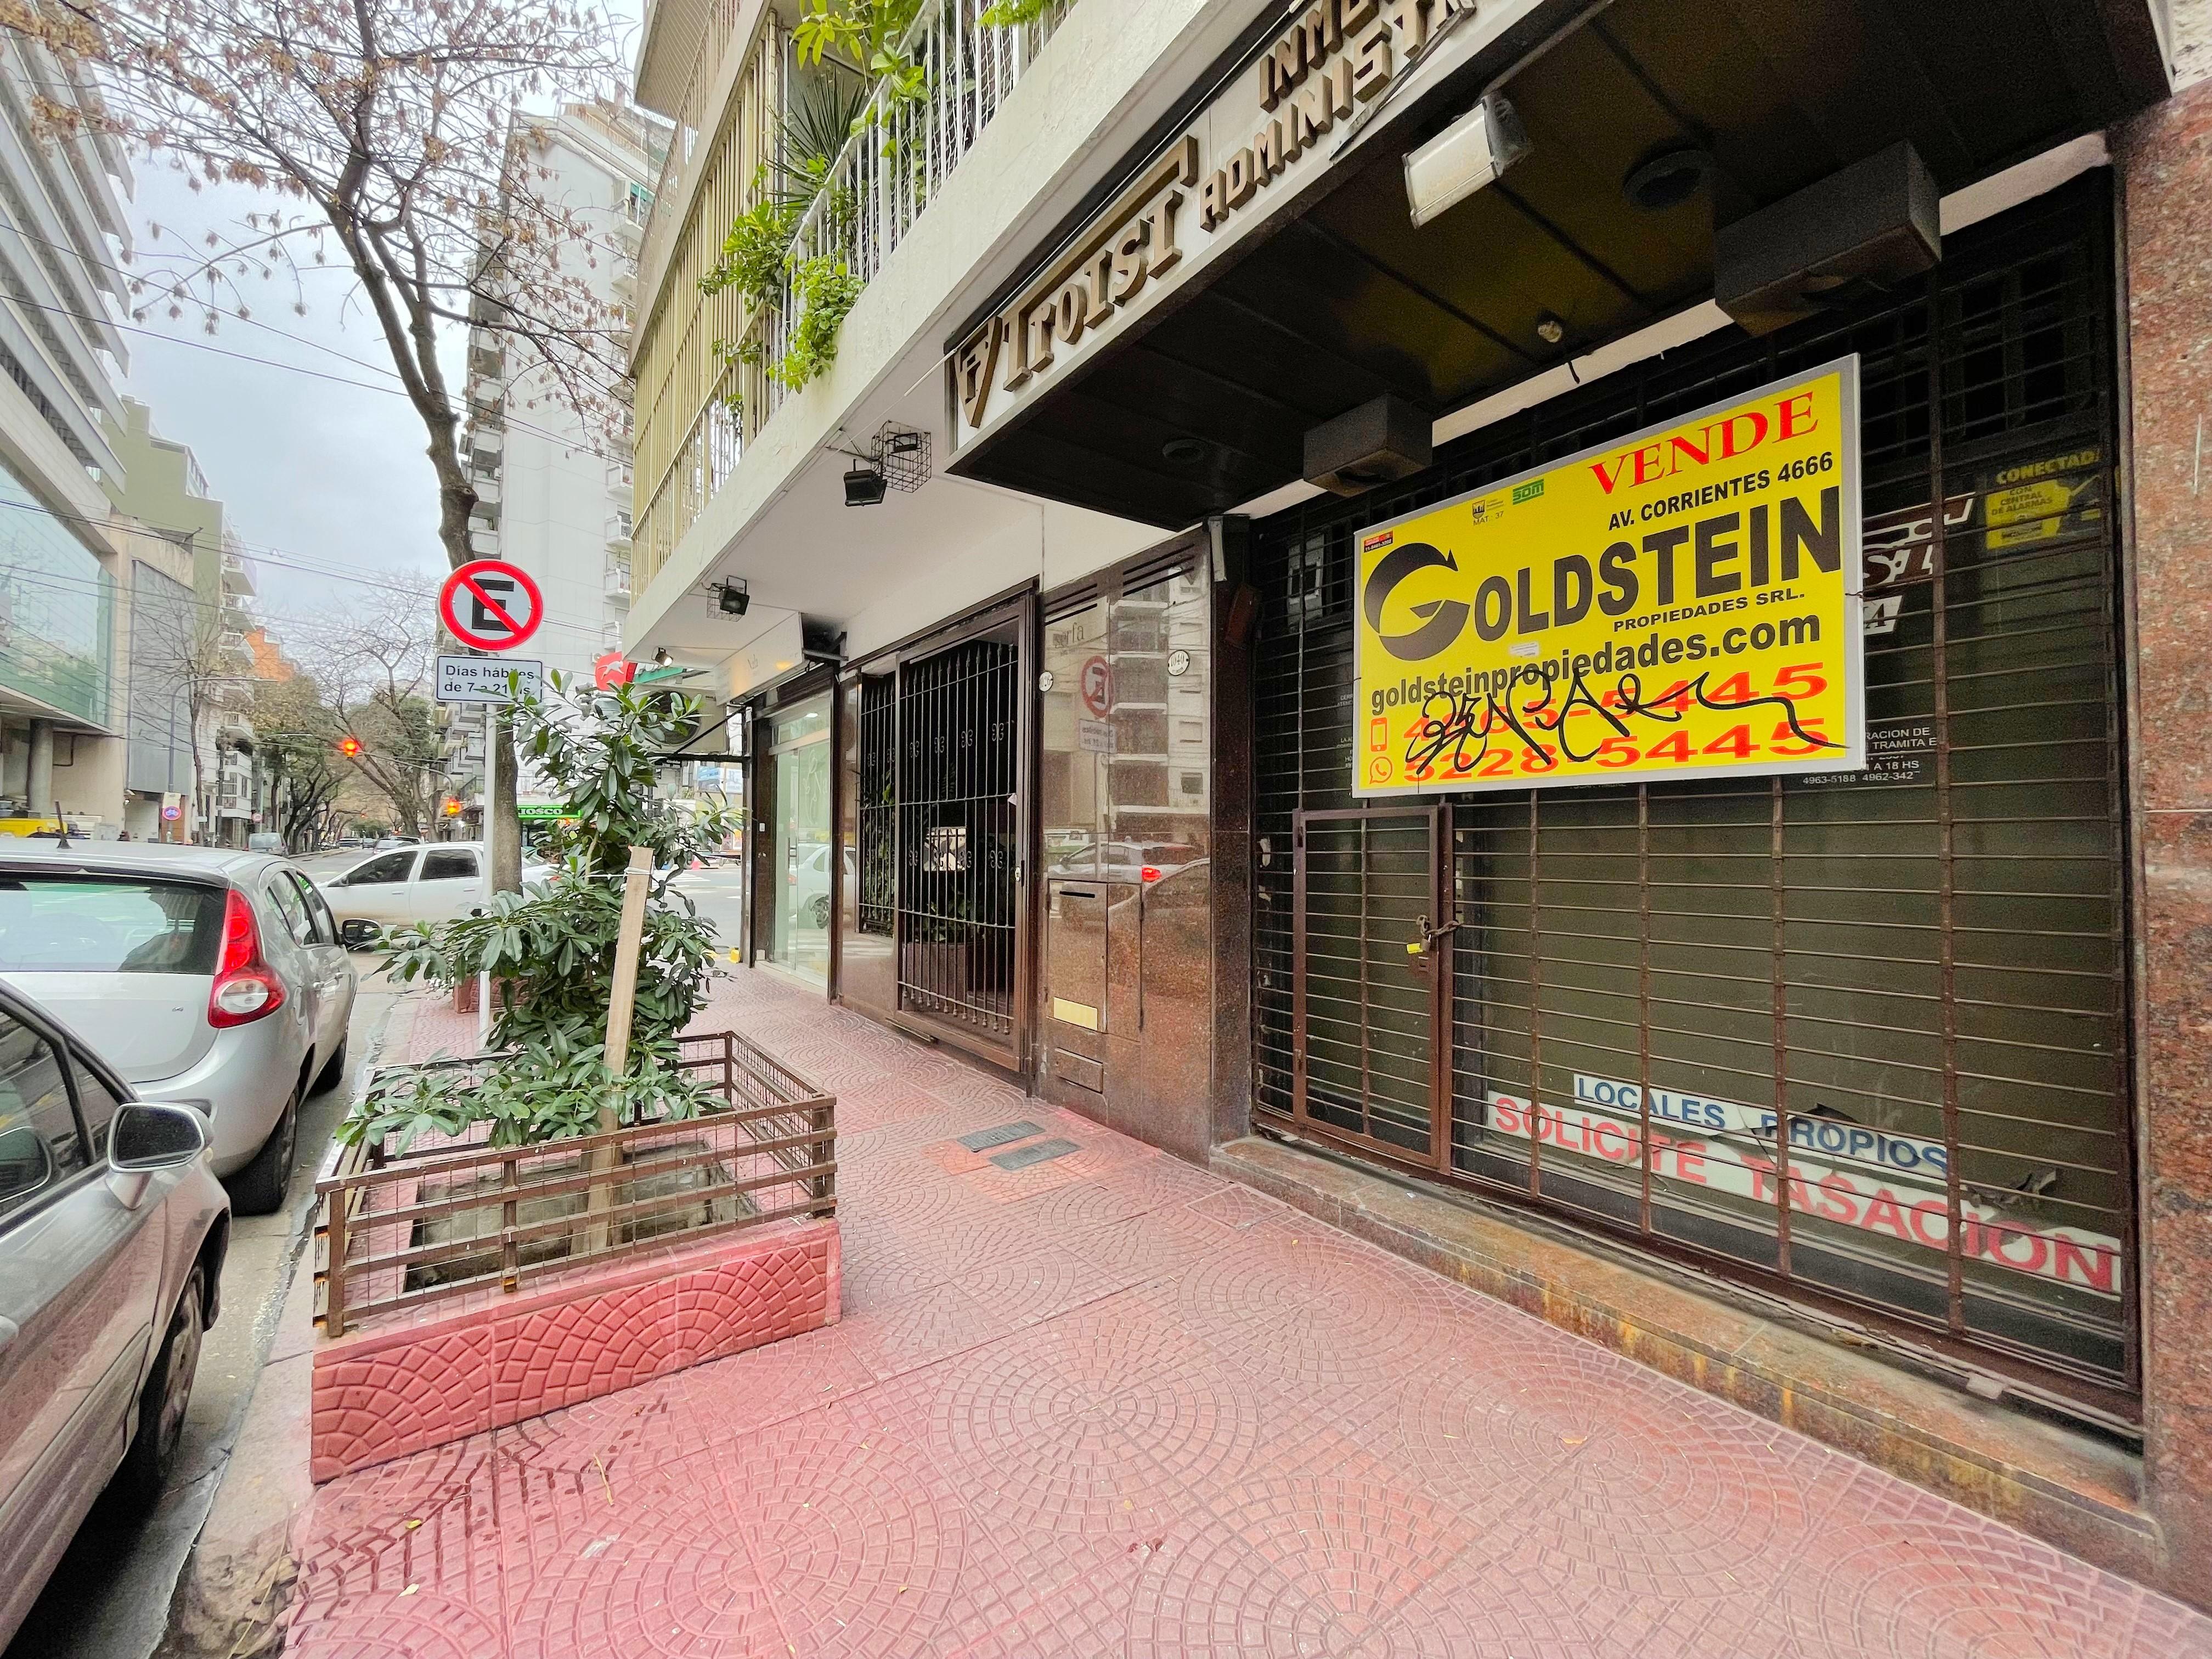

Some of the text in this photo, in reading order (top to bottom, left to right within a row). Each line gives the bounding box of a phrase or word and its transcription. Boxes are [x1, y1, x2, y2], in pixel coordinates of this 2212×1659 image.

[1588, 391, 1819, 495] VENDE
[1608, 451, 1833, 531] AV. CORRIENTES 4666
[1363, 486, 1842, 662] GOLDSTEIN
[472, 578, 514, 632] E
[1613, 588, 1806, 632] PROPIEDADES SRL.
[444, 681, 462, 692] de
[467, 682, 475, 692] 7
[494, 684, 507, 694] 21
[445, 665, 534, 679] Días hábes
[1371, 613, 1820, 716] goldsteinpropiedades.com
[1403, 718, 1829, 782] 5228-5445
[1872, 738, 1926, 750] TRAMITA
[1912, 727, 1931, 736] DE
[1802, 771, 1920, 785] 4963-5188 4962-342
[1887, 761, 1899, 770] 18
[1902, 760, 1920, 769] HS
[1578, 1077, 1948, 1178] LOCALES PROPIOS
[1496, 1097, 2114, 1294] SOLICITE TASACION
